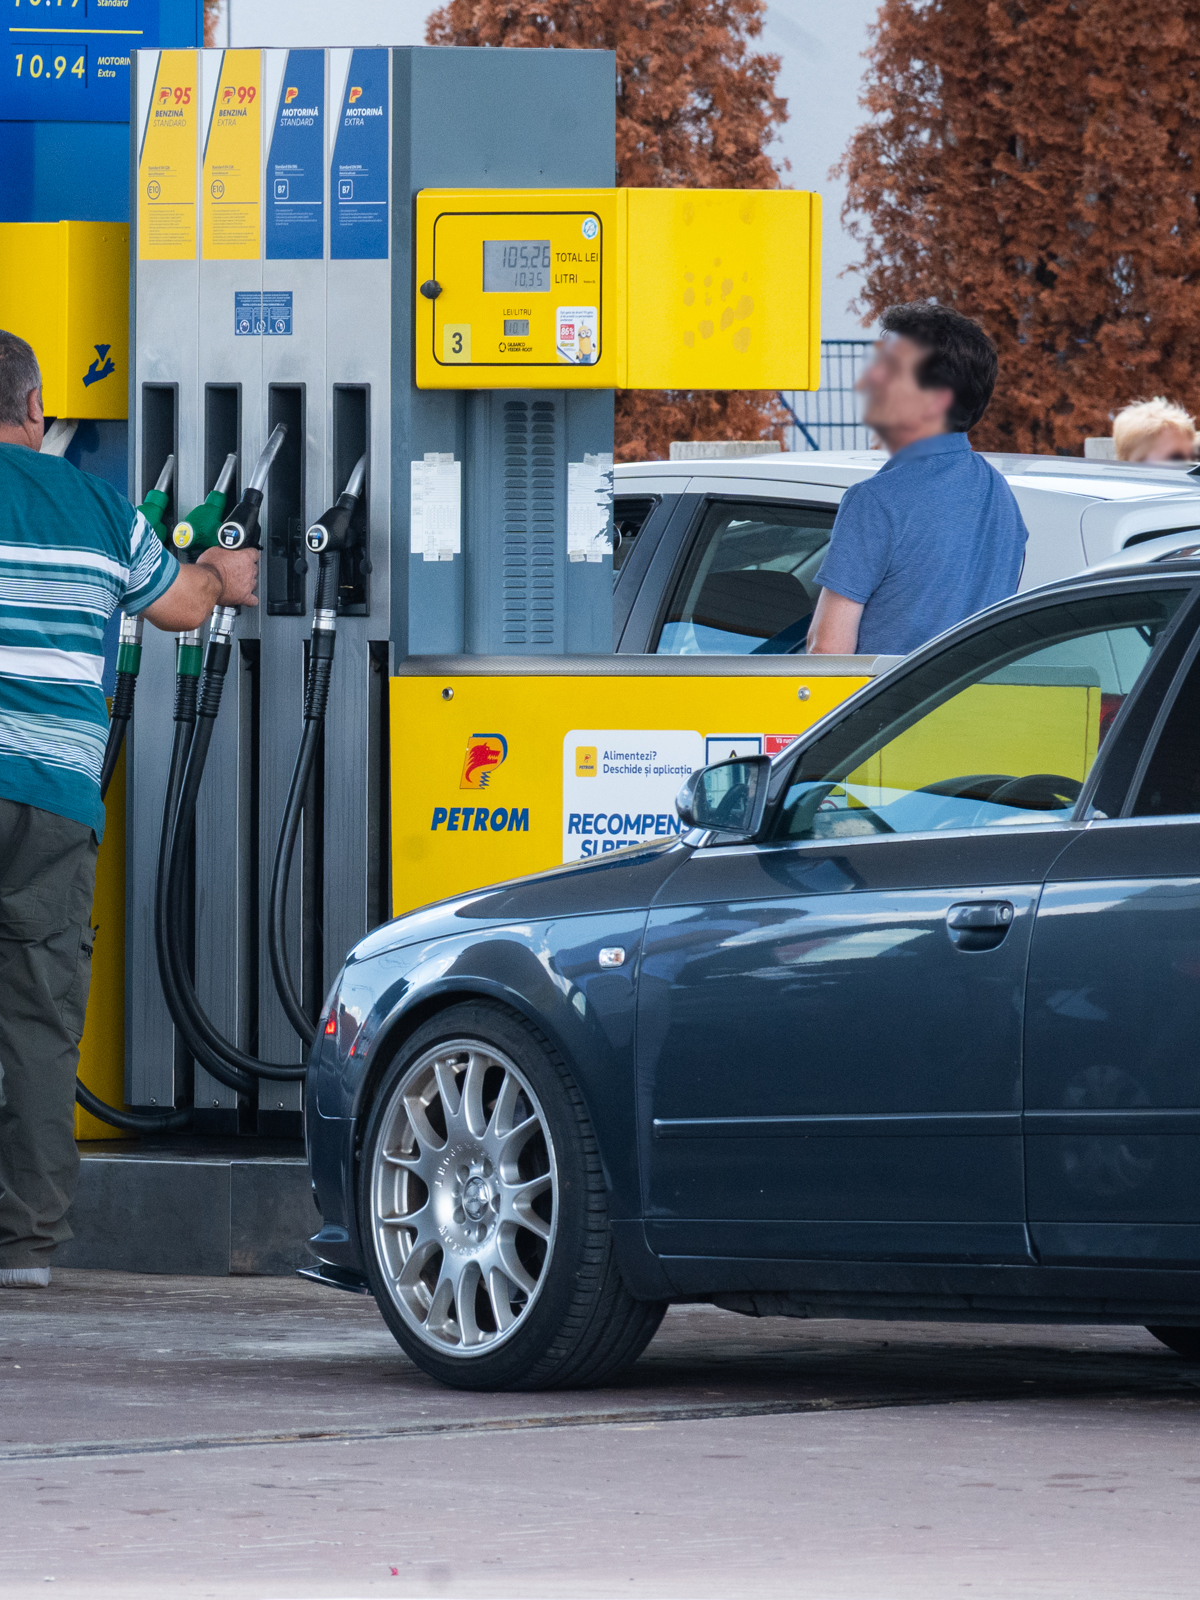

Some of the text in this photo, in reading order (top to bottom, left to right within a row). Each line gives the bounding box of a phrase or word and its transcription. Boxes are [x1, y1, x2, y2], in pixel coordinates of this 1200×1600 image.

[97, 56, 131, 66] MOTORIN
[16, 54, 85, 79] 10.94
[97, 68, 116, 78] Extra
[174, 86, 192, 104] 95
[237, 86, 256, 104] 99
[282, 106, 319, 116] MOTORINĂ
[346, 106, 383, 116] MOTORINĂ
[153, 119, 187, 128] STANDARD
[217, 118, 236, 126] EXTRA
[280, 118, 314, 126] STANDARD
[344, 118, 364, 126] EXTRA
[148, 186, 159, 194] E10
[213, 185, 223, 193] E10
[278, 185, 286, 194] B7
[342, 185, 350, 194] B7
[555, 252, 599, 262] TOTAL LEI
[555, 274, 578, 284] LITRI
[452, 332, 463, 354] 3
[602, 750, 657, 761] Alimentezi?
[603, 764, 692, 778] Deschide și aplicația
[430, 806, 530, 832] PETROM
[568, 812, 693, 836] RECOMPENS
